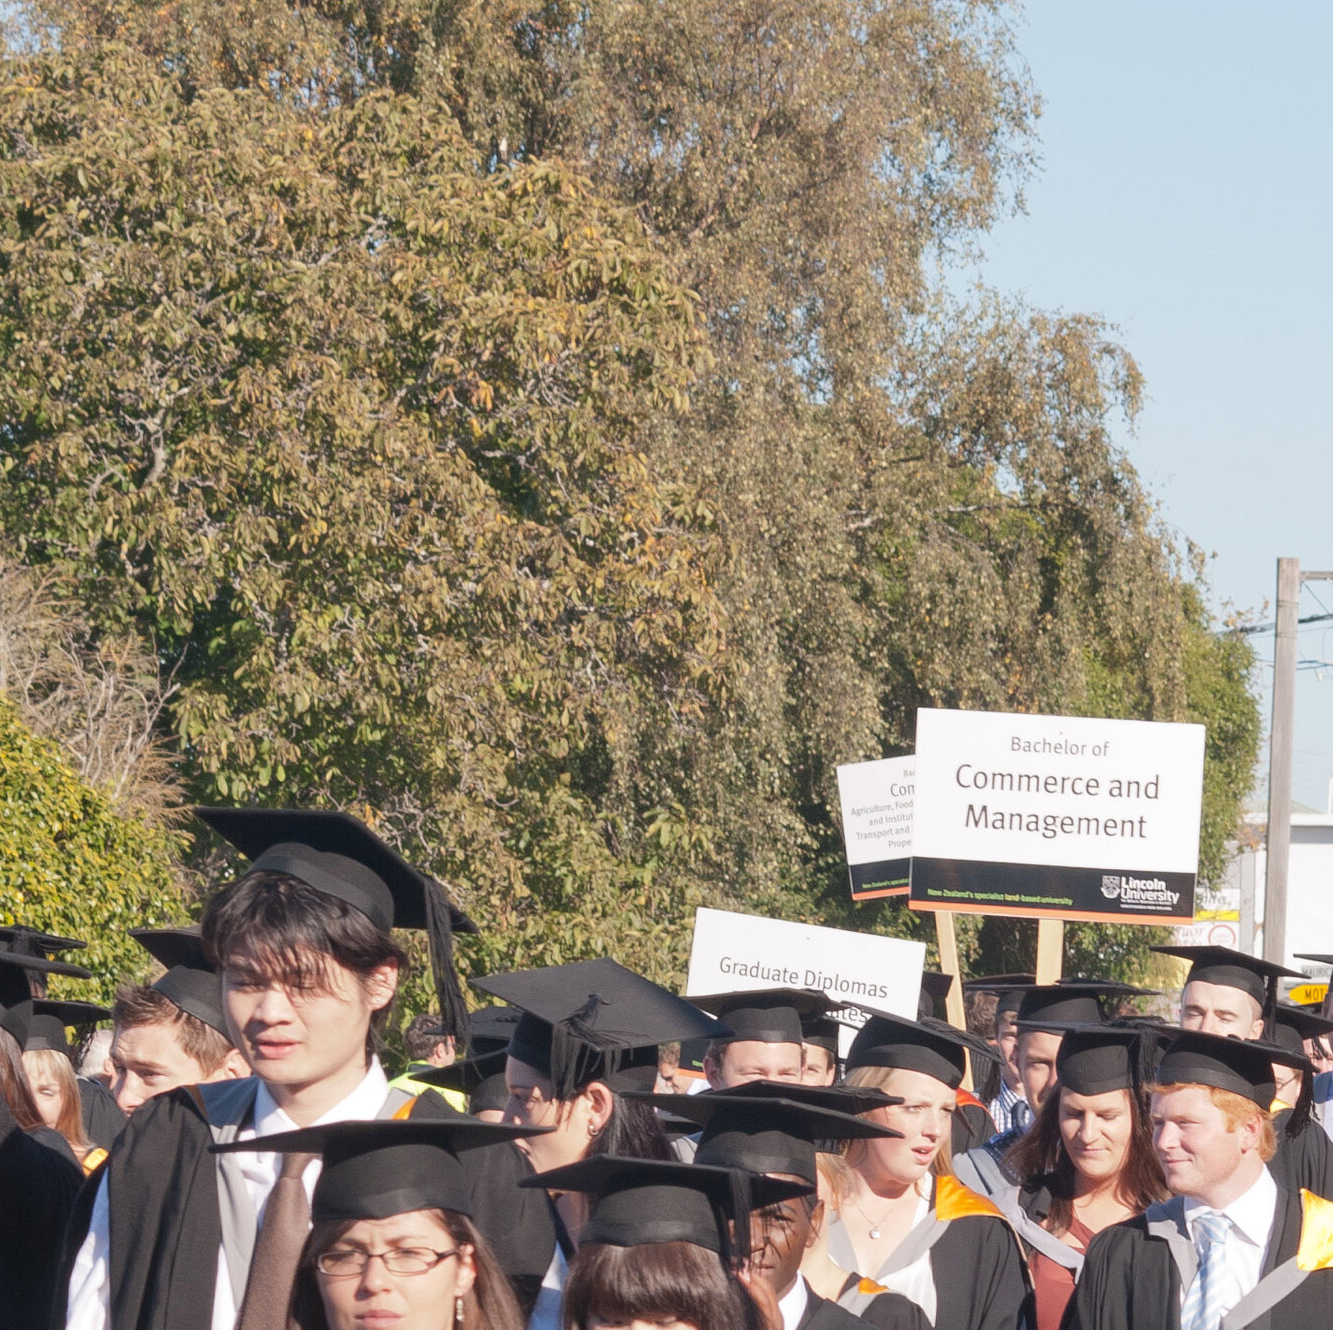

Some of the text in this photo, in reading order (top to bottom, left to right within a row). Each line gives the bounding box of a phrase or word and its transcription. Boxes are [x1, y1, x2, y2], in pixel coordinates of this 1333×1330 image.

[1011, 736, 1110, 757] Bachelor of
[955, 764, 1160, 799] Commerce and
[965, 804, 1147, 839] Management
[1121, 876, 1166, 890] Lincoln
[1121, 887, 1180, 905] University
[720, 956, 888, 998] Graduate Diplomas
